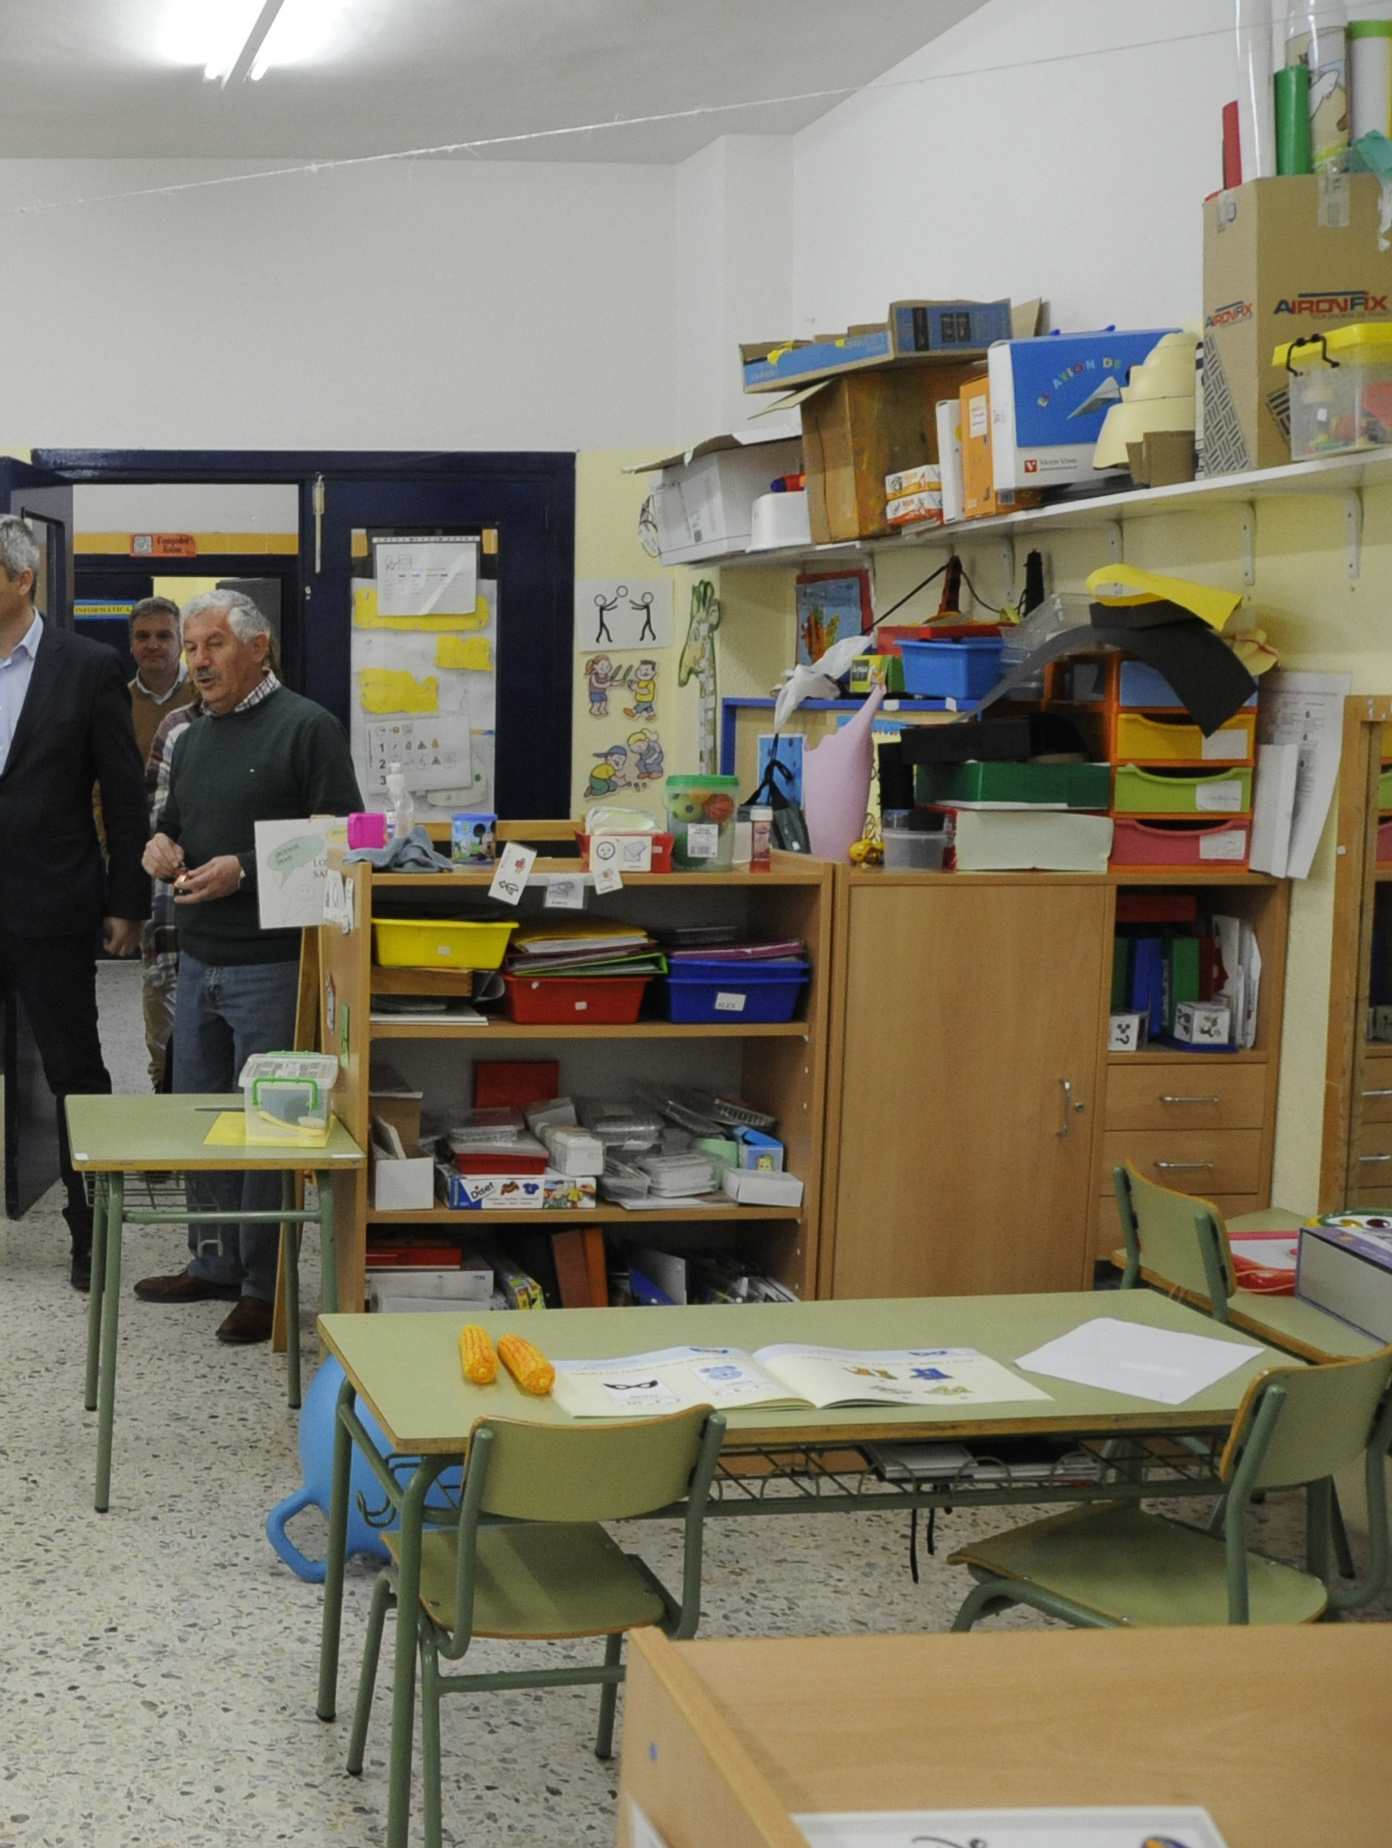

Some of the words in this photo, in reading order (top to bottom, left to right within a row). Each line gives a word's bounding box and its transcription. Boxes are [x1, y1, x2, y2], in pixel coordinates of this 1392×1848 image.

[1205, 301, 1253, 329] AIRONFIX
[1274, 295, 1388, 315] AIRONFIX
[470, 1181, 495, 1200] Diset
